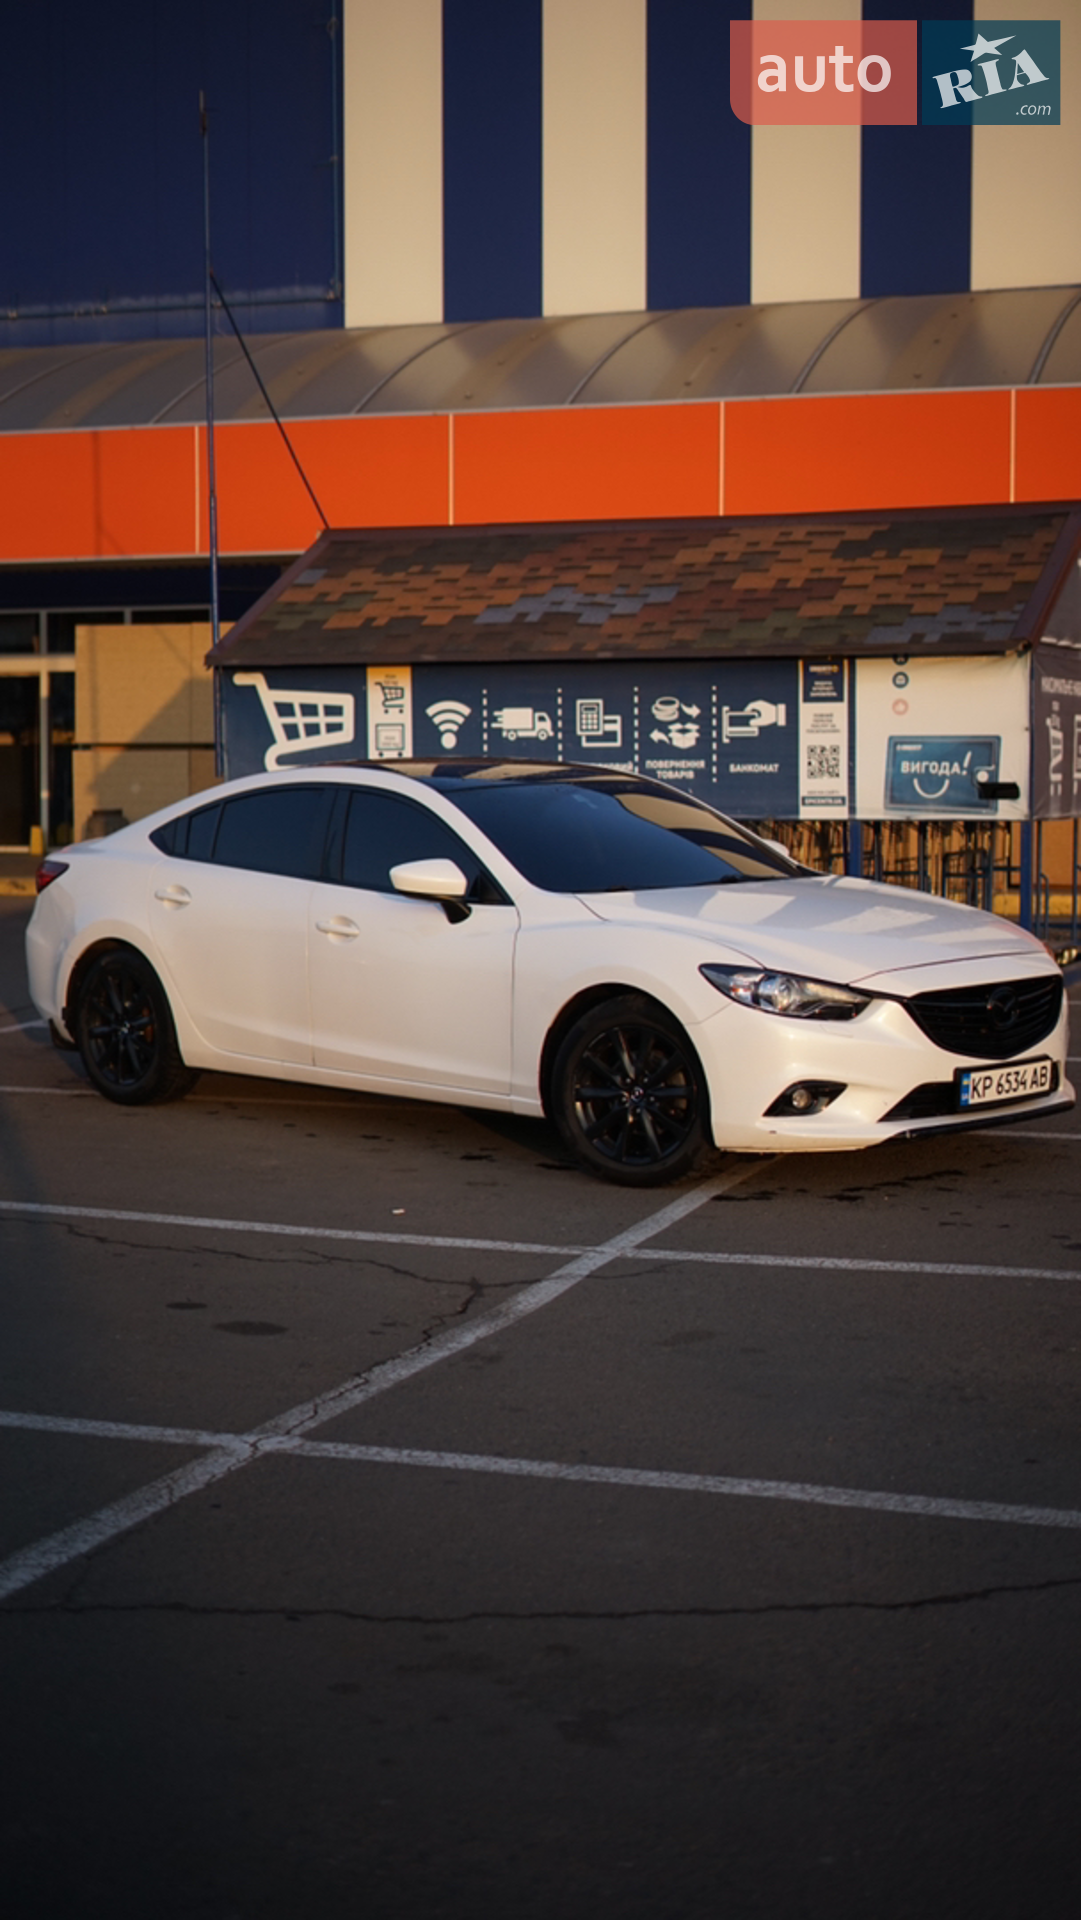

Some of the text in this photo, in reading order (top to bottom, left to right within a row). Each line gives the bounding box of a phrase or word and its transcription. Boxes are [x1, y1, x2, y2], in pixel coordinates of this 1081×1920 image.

[645, 759, 706, 769] ПОВЕРНЕННЯ
[729, 763, 780, 773] БАНКОМАТ
[900, 750, 972, 777] ВИГОДА!
[656, 769, 695, 780] ТОВАРІВ
[970, 1065, 1048, 1100] KP 6534 AB
